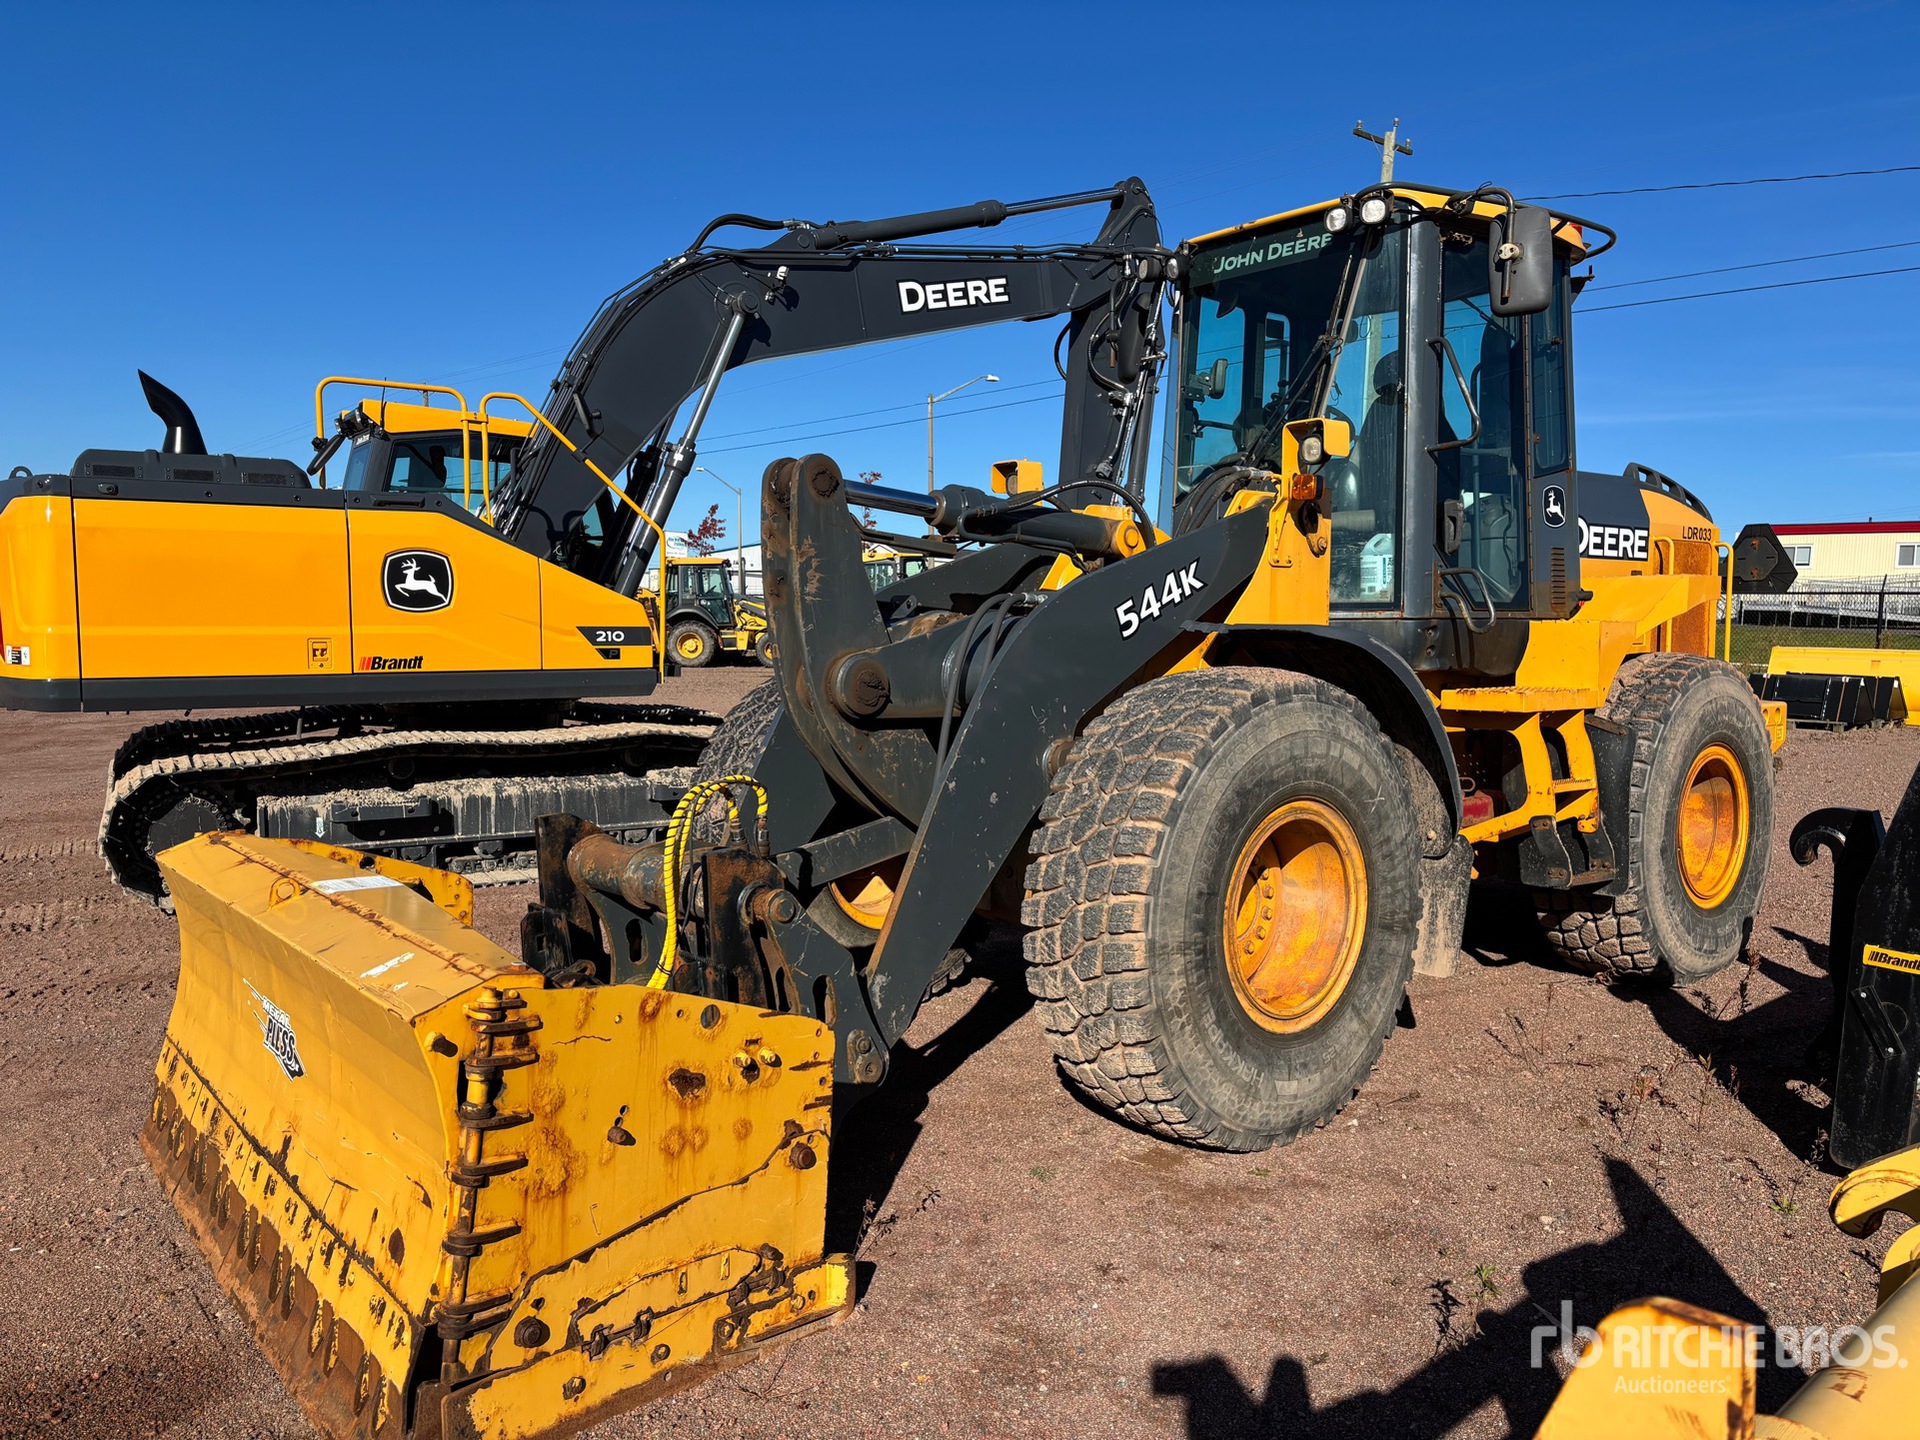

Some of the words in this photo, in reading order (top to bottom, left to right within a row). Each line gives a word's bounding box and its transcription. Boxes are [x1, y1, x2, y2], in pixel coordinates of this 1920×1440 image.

[1213, 249, 1263, 274] JOHN
[898, 278, 1009, 312] DEERE
[1682, 526, 1712, 541] LDR033
[1115, 560, 1204, 638] 544K
[595, 630, 625, 642] 210
[370, 656, 423, 670] Brandt
[263, 999, 290, 1027] METAL
[265, 1016, 295, 1063] PLESS
